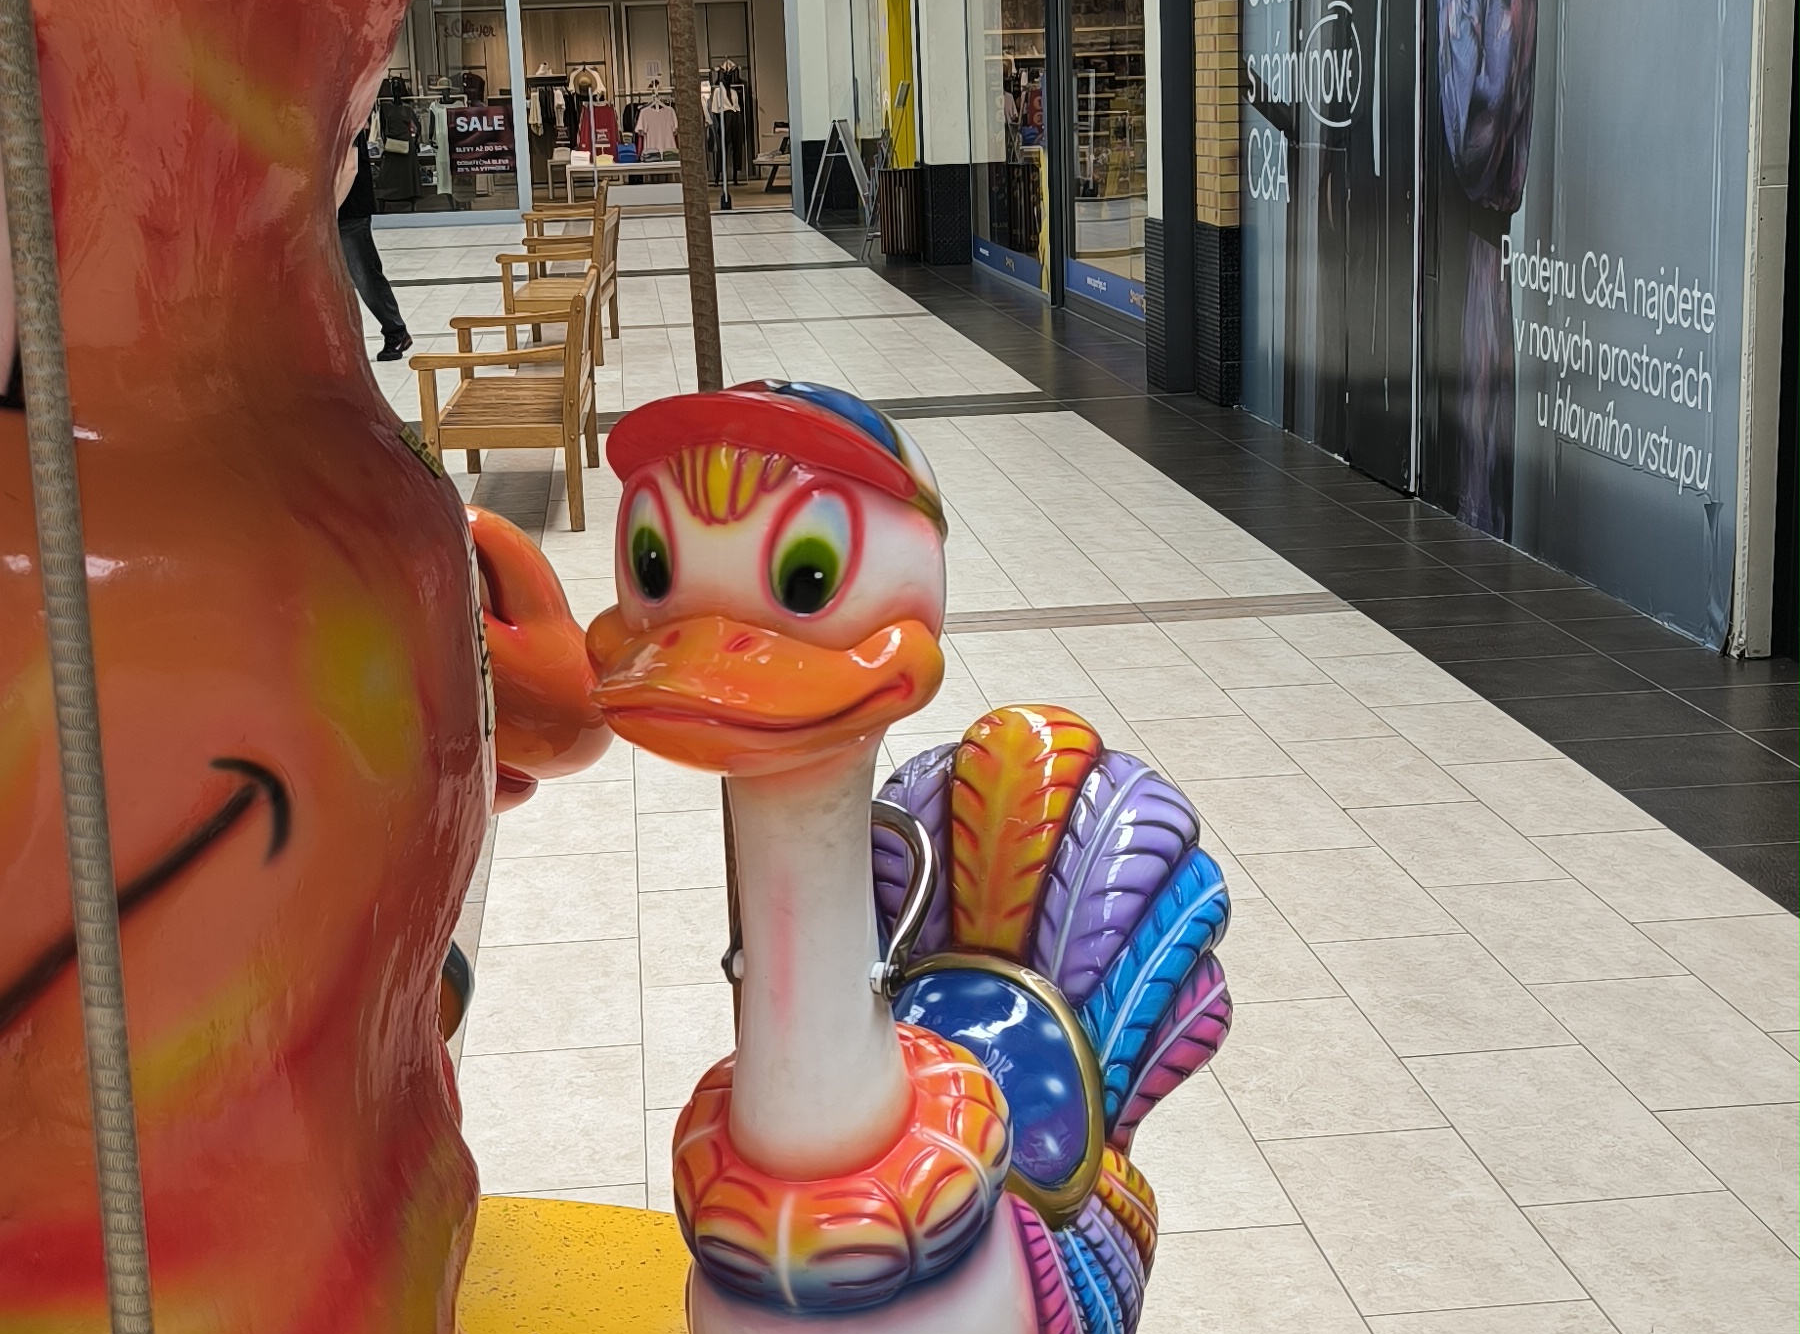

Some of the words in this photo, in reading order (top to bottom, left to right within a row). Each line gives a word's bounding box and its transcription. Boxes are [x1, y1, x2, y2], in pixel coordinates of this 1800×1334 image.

[1247, 53, 1256, 104] s
[1261, 29, 1303, 104] námi
[456, 115, 505, 132] SALE
[1248, 127, 1291, 203] C&A
[1500, 234, 1576, 306] Prodejnu
[1581, 251, 1628, 313] C&A
[1633, 266, 1716, 335] najdete
[1514, 318, 1526, 352] v
[1528, 317, 1593, 379] nových
[1598, 342, 1712, 413] prostorách
[1536, 391, 1548, 427] u
[1553, 381, 1633, 460] hlavního
[1638, 425, 1712, 495] vstupu
